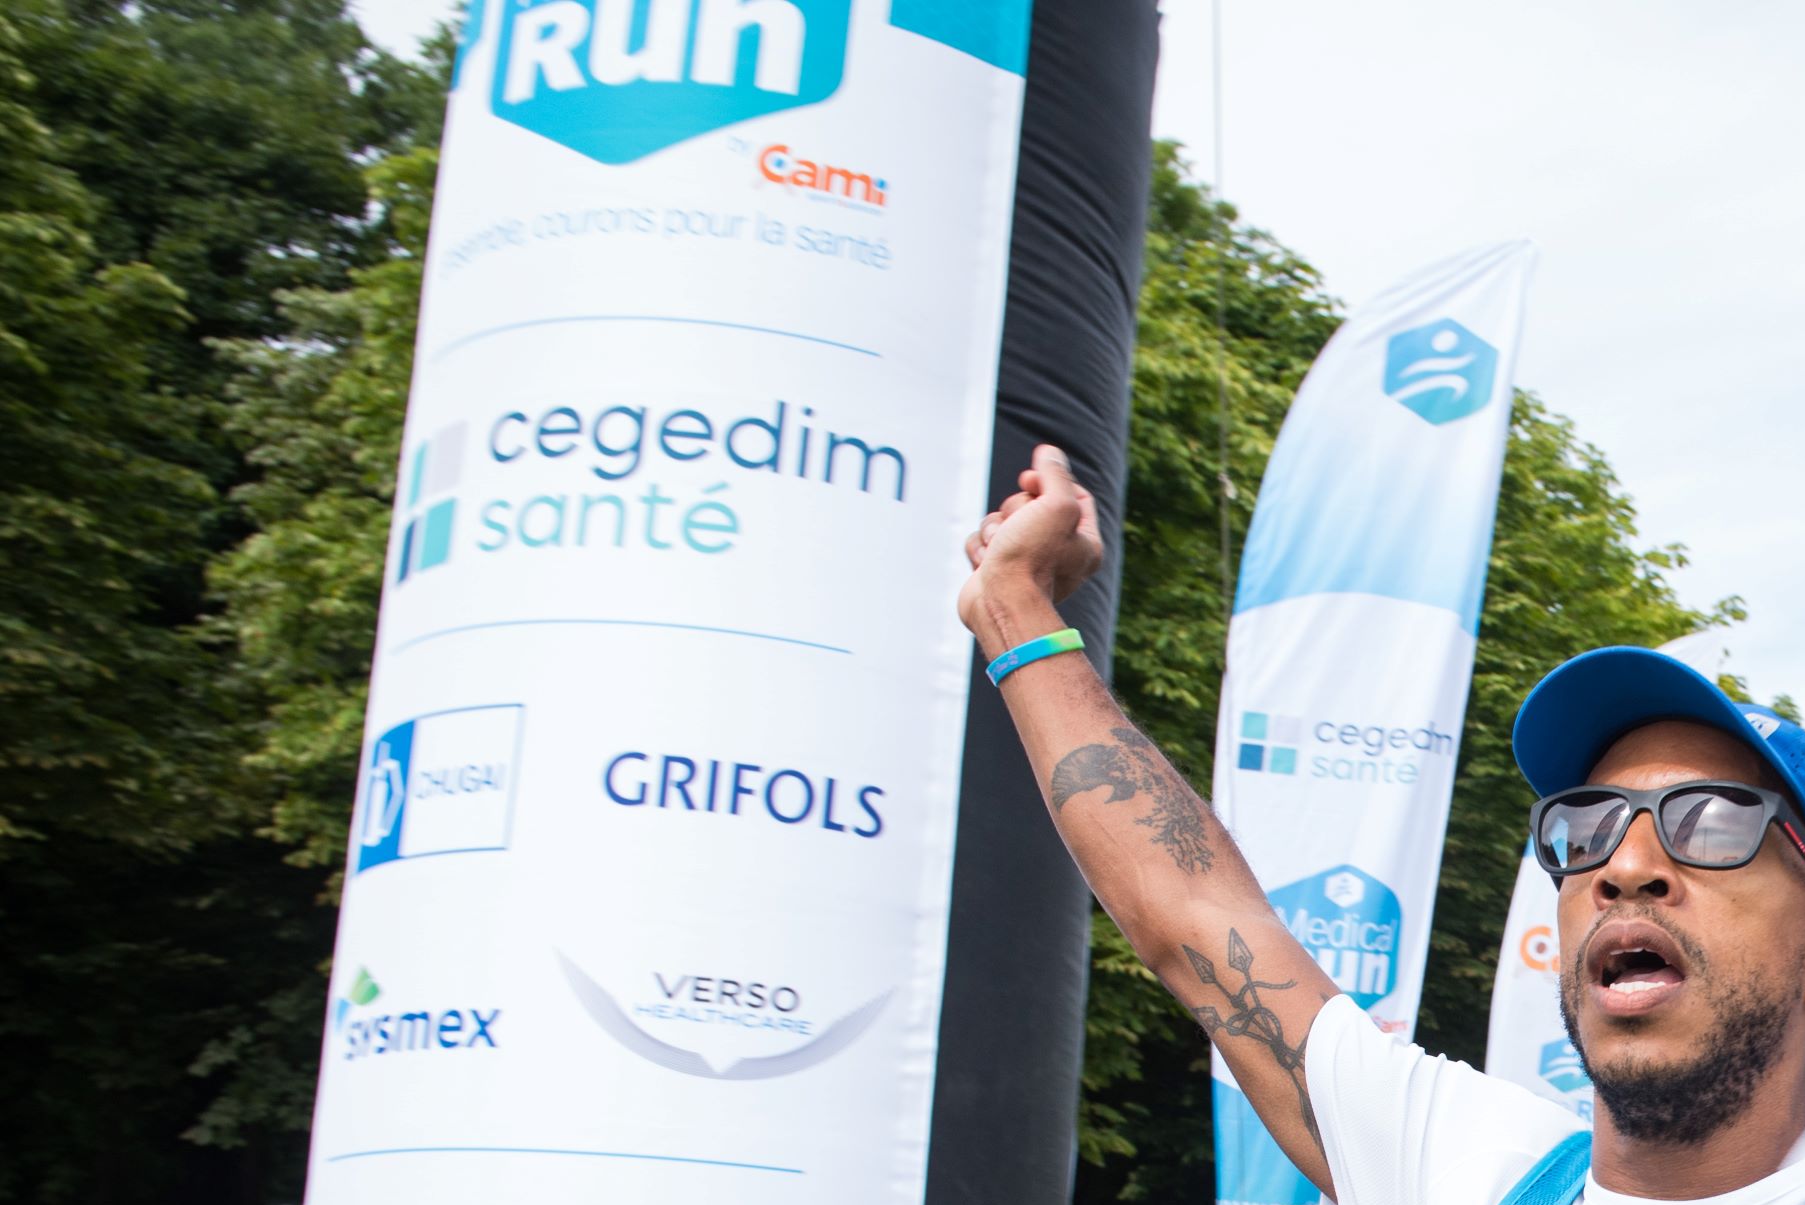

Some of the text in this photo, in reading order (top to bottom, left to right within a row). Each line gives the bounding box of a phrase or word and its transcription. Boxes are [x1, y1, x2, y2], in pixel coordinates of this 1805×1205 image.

[757, 143, 887, 207] Cami
[530, 205, 655, 242] courons
[664, 208, 748, 240] pour
[754, 212, 787, 247] la
[795, 222, 895, 271] santé
[488, 400, 908, 503] cegedim
[476, 481, 741, 555] santé
[604, 750, 886, 839] GRIFOLS
[1311, 751, 1419, 784] santé
[634, 1002, 813, 1037] HEALTHCARE
[652, 971, 801, 1013] VERSO
[344, 1008, 502, 1061] sysmex
